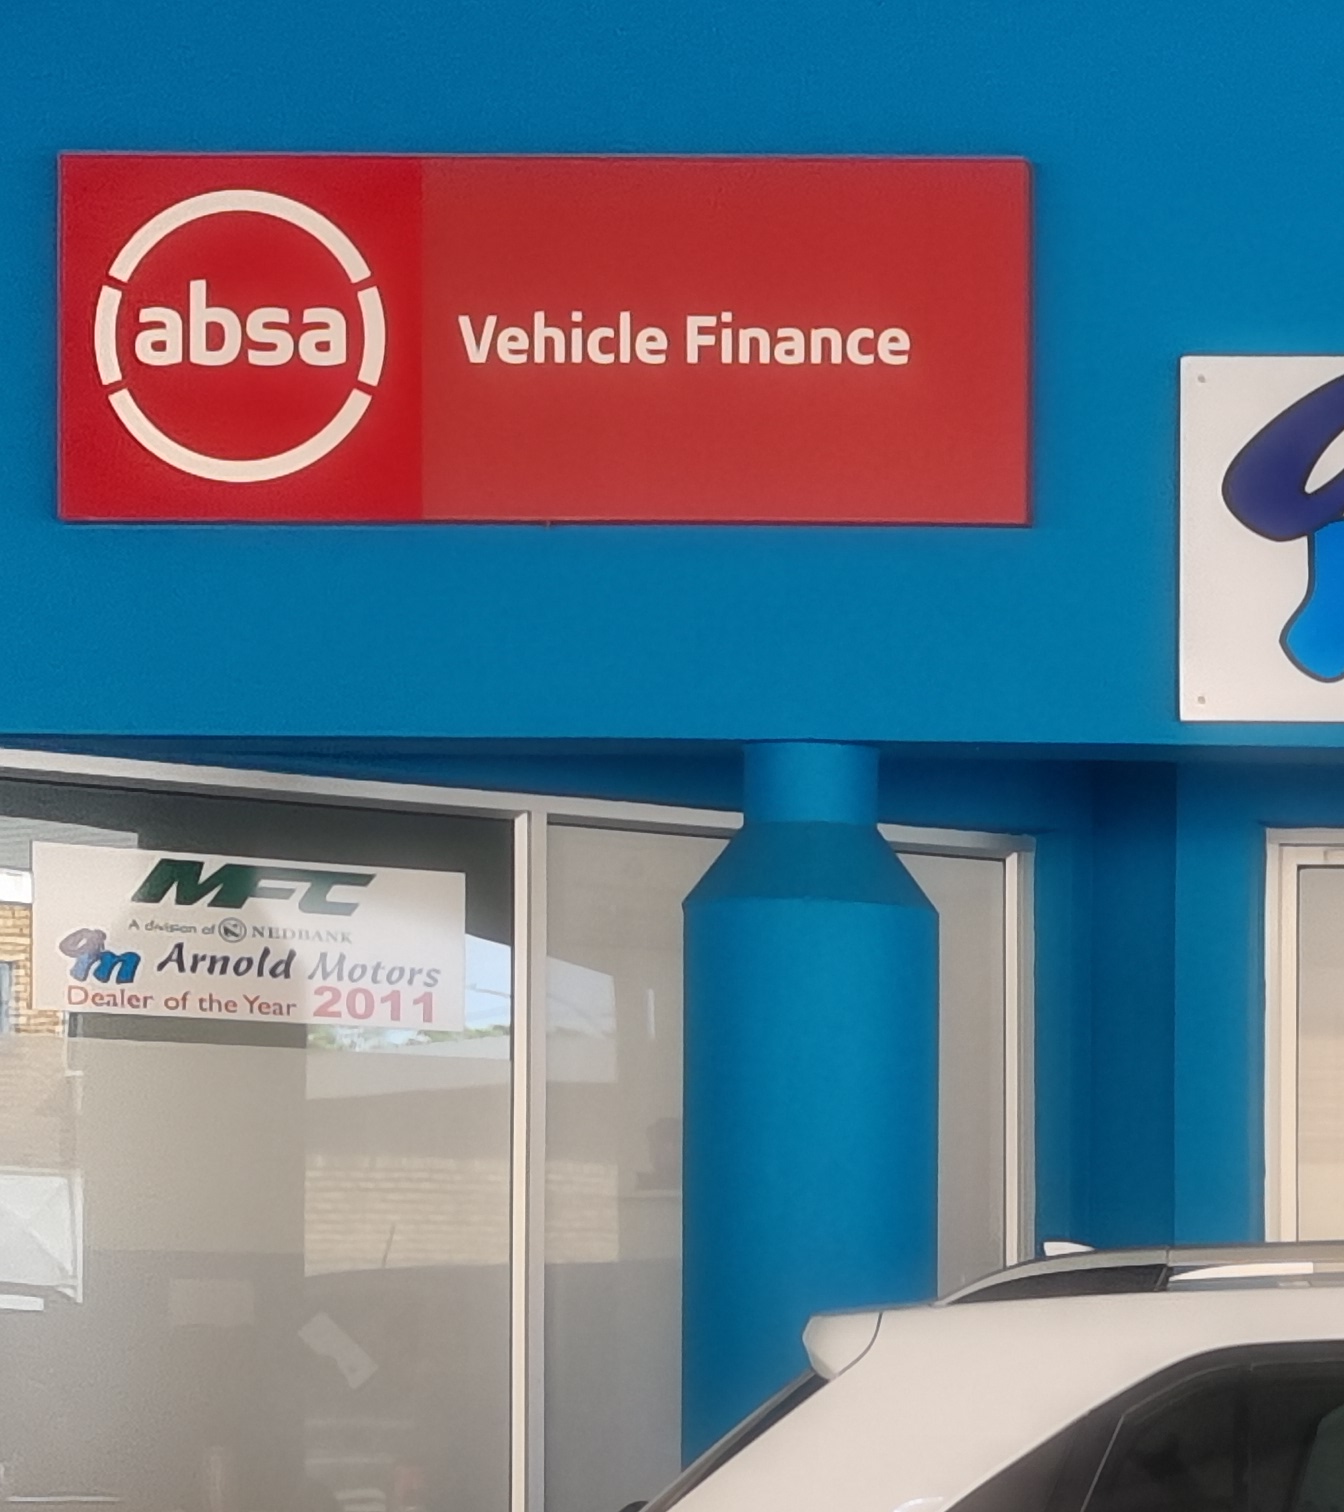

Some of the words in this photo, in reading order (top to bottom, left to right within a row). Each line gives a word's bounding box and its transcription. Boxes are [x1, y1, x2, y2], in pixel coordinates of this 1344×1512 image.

[134, 278, 348, 367] absa
[458, 312, 669, 365] Vehicle
[685, 312, 911, 366] Finance
[131, 857, 377, 917] MFC
[128, 918, 140, 932] A
[201, 924, 216, 935] of
[251, 926, 353, 944] NEDBANK
[156, 941, 297, 980] Arnold
[307, 952, 442, 987] Motors
[67, 984, 153, 1010] Dealer
[163, 990, 191, 1011] of
[199, 991, 238, 1014] the
[243, 994, 298, 1017] Year
[313, 985, 435, 1023] 2011
